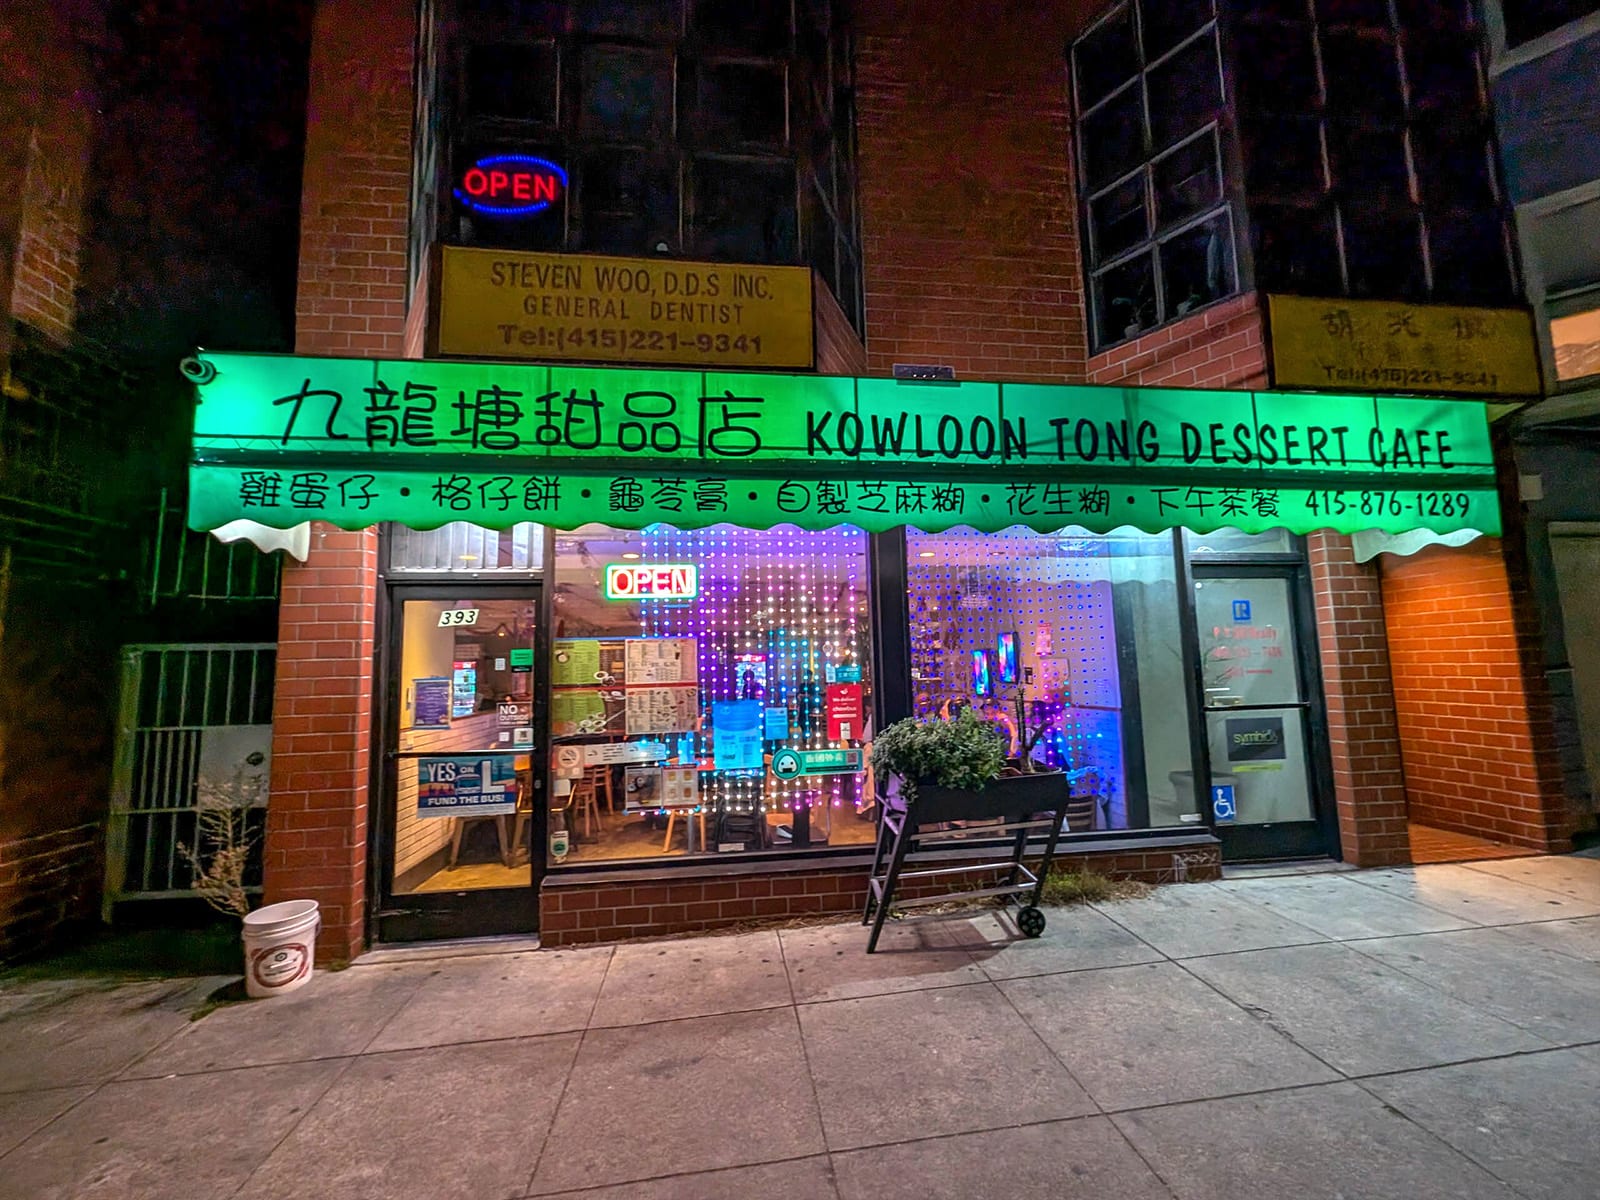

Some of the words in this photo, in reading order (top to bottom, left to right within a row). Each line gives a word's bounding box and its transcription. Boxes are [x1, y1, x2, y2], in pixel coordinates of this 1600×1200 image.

[464, 167, 556, 201] OPEN
[490, 261, 582, 289] STEVEN
[596, 268, 658, 297] WOO,
[733, 274, 774, 300] INC.
[524, 294, 629, 320] GENERAL
[651, 300, 744, 325] DENTIST
[498, 323, 762, 355] Tel:(415)221-9341
[273, 378, 764, 457] 九龍塘甜品店
[806, 411, 1028, 460] KOWLOON
[1050, 417, 1160, 463] TONG
[1181, 422, 1350, 467] DESSERT
[1368, 427, 1456, 470] CAFE
[239, 471, 379, 510] 雞蛋仔
[432, 474, 561, 512] 格仔餅
[609, 476, 728, 512] 龜苓膏
[777, 480, 965, 515] 自製芝麻糊
[1006, 482, 1109, 516] 花生糊
[1151, 486, 1280, 518] 下午茶餐
[1305, 490, 1470, 519] 415-876-1289
[612, 568, 692, 595] OPEN
[440, 610, 477, 626] 393
[500, 704, 518, 715] NO
[427, 762, 456, 783] YES
[460, 766, 475, 774] ON
[482, 760, 505, 794] L
[427, 797, 457, 806] FUND
[459, 795, 479, 804] THE
[481, 794, 505, 804] BUS!
